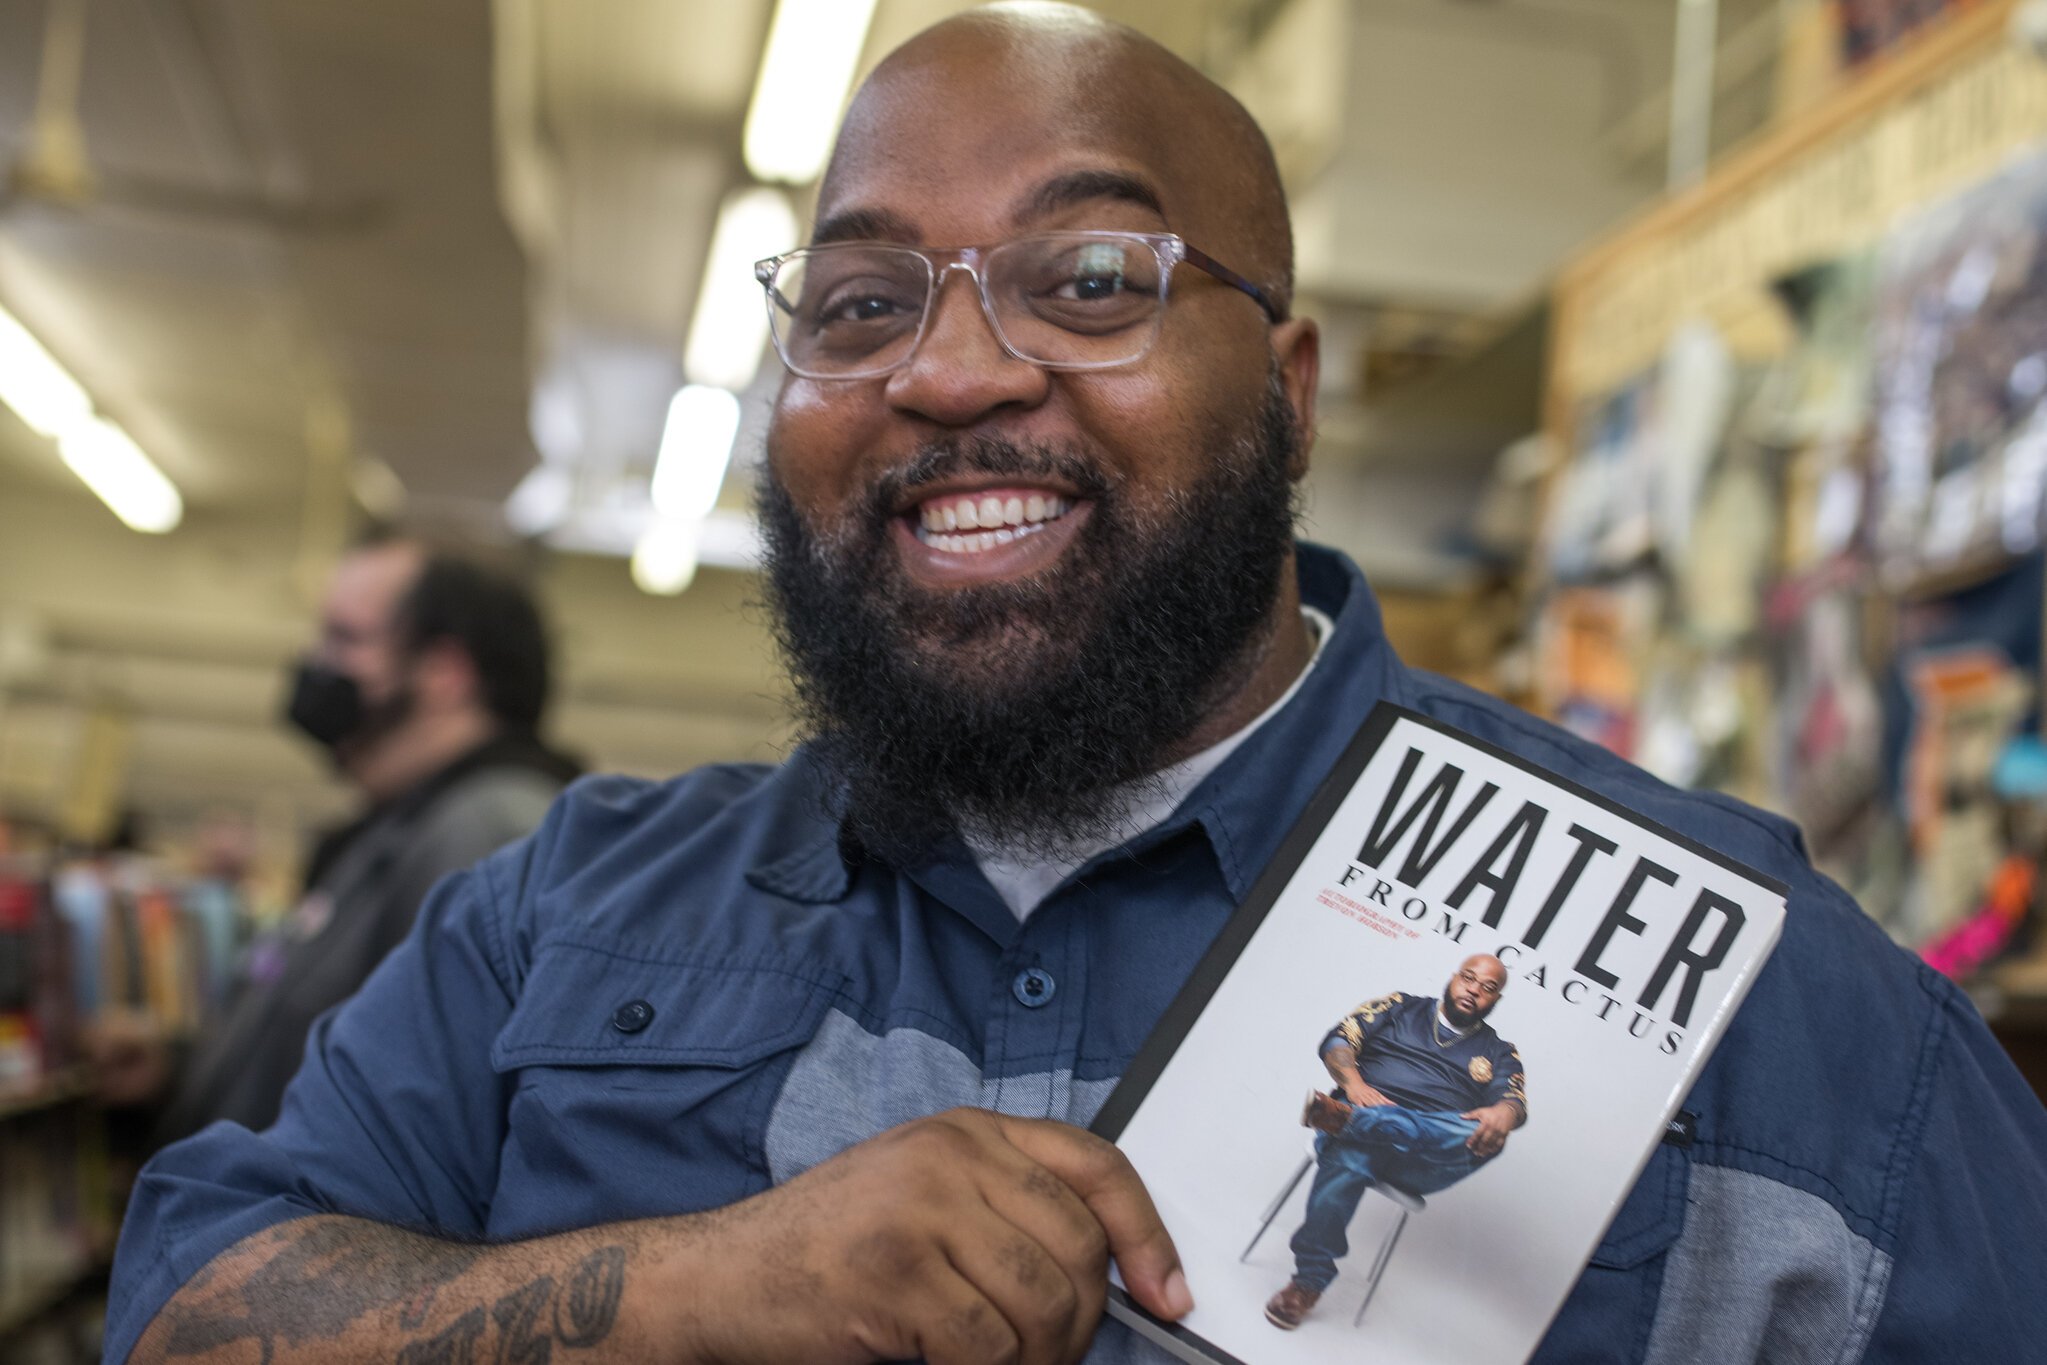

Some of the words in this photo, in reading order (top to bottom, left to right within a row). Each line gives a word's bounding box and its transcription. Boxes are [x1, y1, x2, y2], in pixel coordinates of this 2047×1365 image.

[1336, 864, 1472, 944] FROM
[1496, 945, 1683, 1055] CACTUS
[1357, 747, 1746, 1029] WATER
